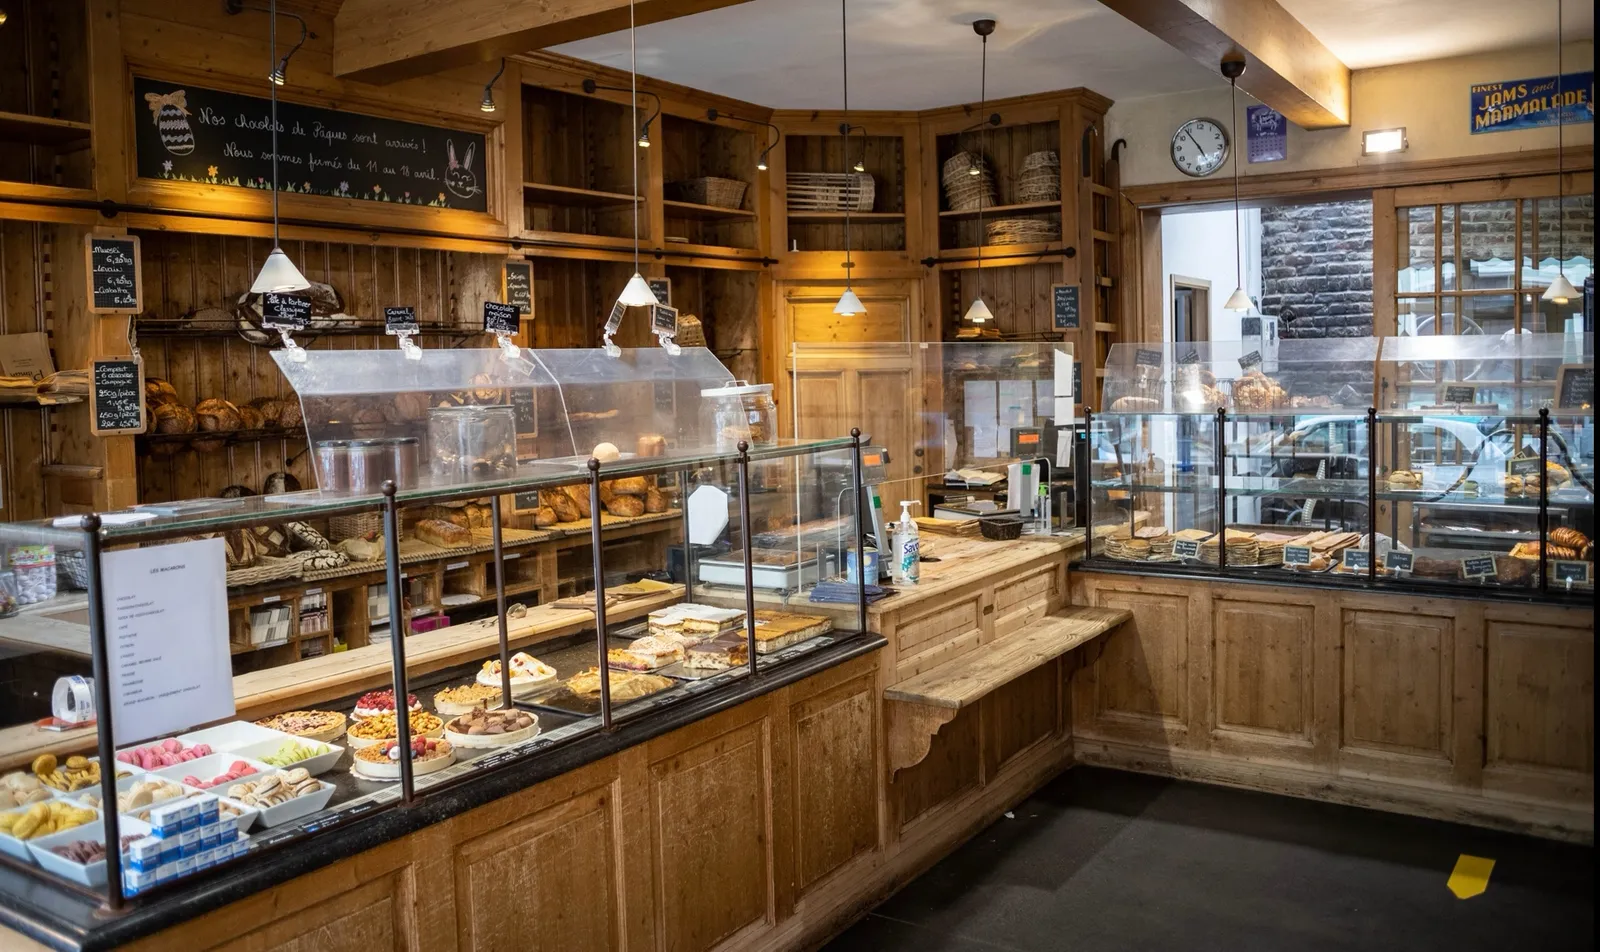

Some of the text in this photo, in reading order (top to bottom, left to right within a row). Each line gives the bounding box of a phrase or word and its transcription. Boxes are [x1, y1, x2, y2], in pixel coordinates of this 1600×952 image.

[1472, 84, 1503, 93] FINEST
[1479, 81, 1556, 110] JAMS and
[1475, 89, 1588, 130] MARMALADE
[198, 106, 226, 126] Nos
[291, 120, 306, 136] de
[312, 120, 348, 147] Pâques
[352, 131, 379, 145] sont
[385, 138, 419, 151] arrivés
[1214, 132, 1221, 140] 2
[1216, 143, 1223, 151] 3
[223, 141, 254, 159] Nous
[308, 152, 343, 173] fermés
[347, 158, 361, 171] du
[366, 160, 378, 173] 11
[382, 166, 397, 175] au
[1186, 161, 1192, 169] 7
[1195, 164, 1202, 172] 6
[160, 564, 186, 573] MACARONS
